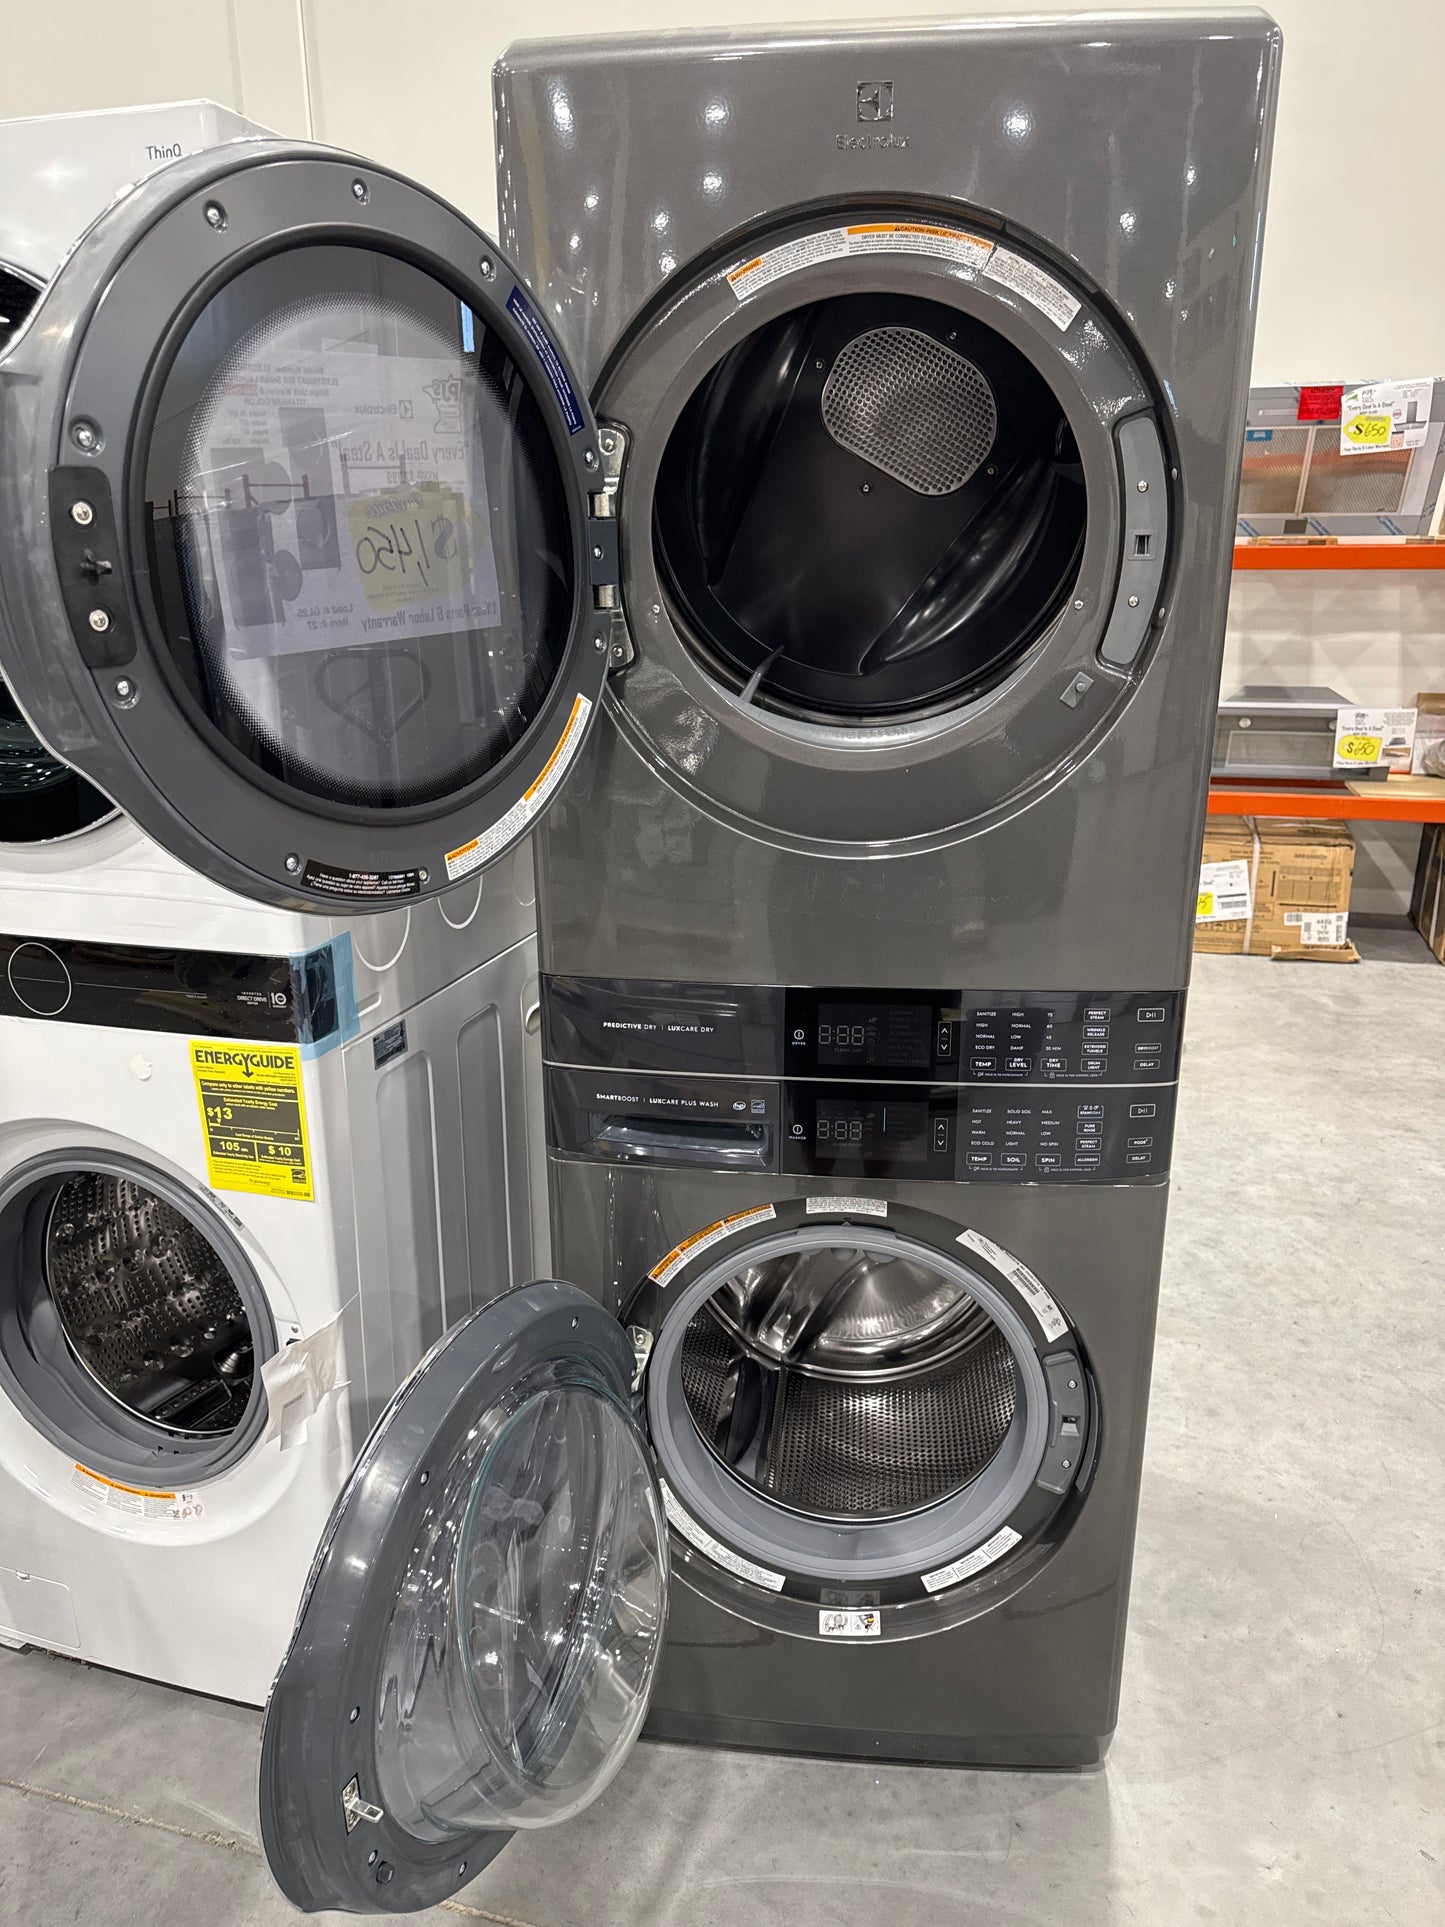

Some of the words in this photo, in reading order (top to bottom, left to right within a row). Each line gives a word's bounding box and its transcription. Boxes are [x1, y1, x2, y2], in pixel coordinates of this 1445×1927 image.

[836, 134, 910, 150] Electrolux
[145, 143, 182, 160] ThinQ
[1353, 422, 1386, 437] $650
[1347, 741, 1375, 756] $650
[271, 992, 286, 1005] 10
[195, 1050, 295, 1069] ENERGYGUIDE
[596, 1094, 639, 1102] SMARTBOOST
[206, 1106, 232, 1120] $13
[220, 1141, 240, 1151] 105
[268, 1146, 275, 1155] $
[279, 1146, 291, 1156] 10
